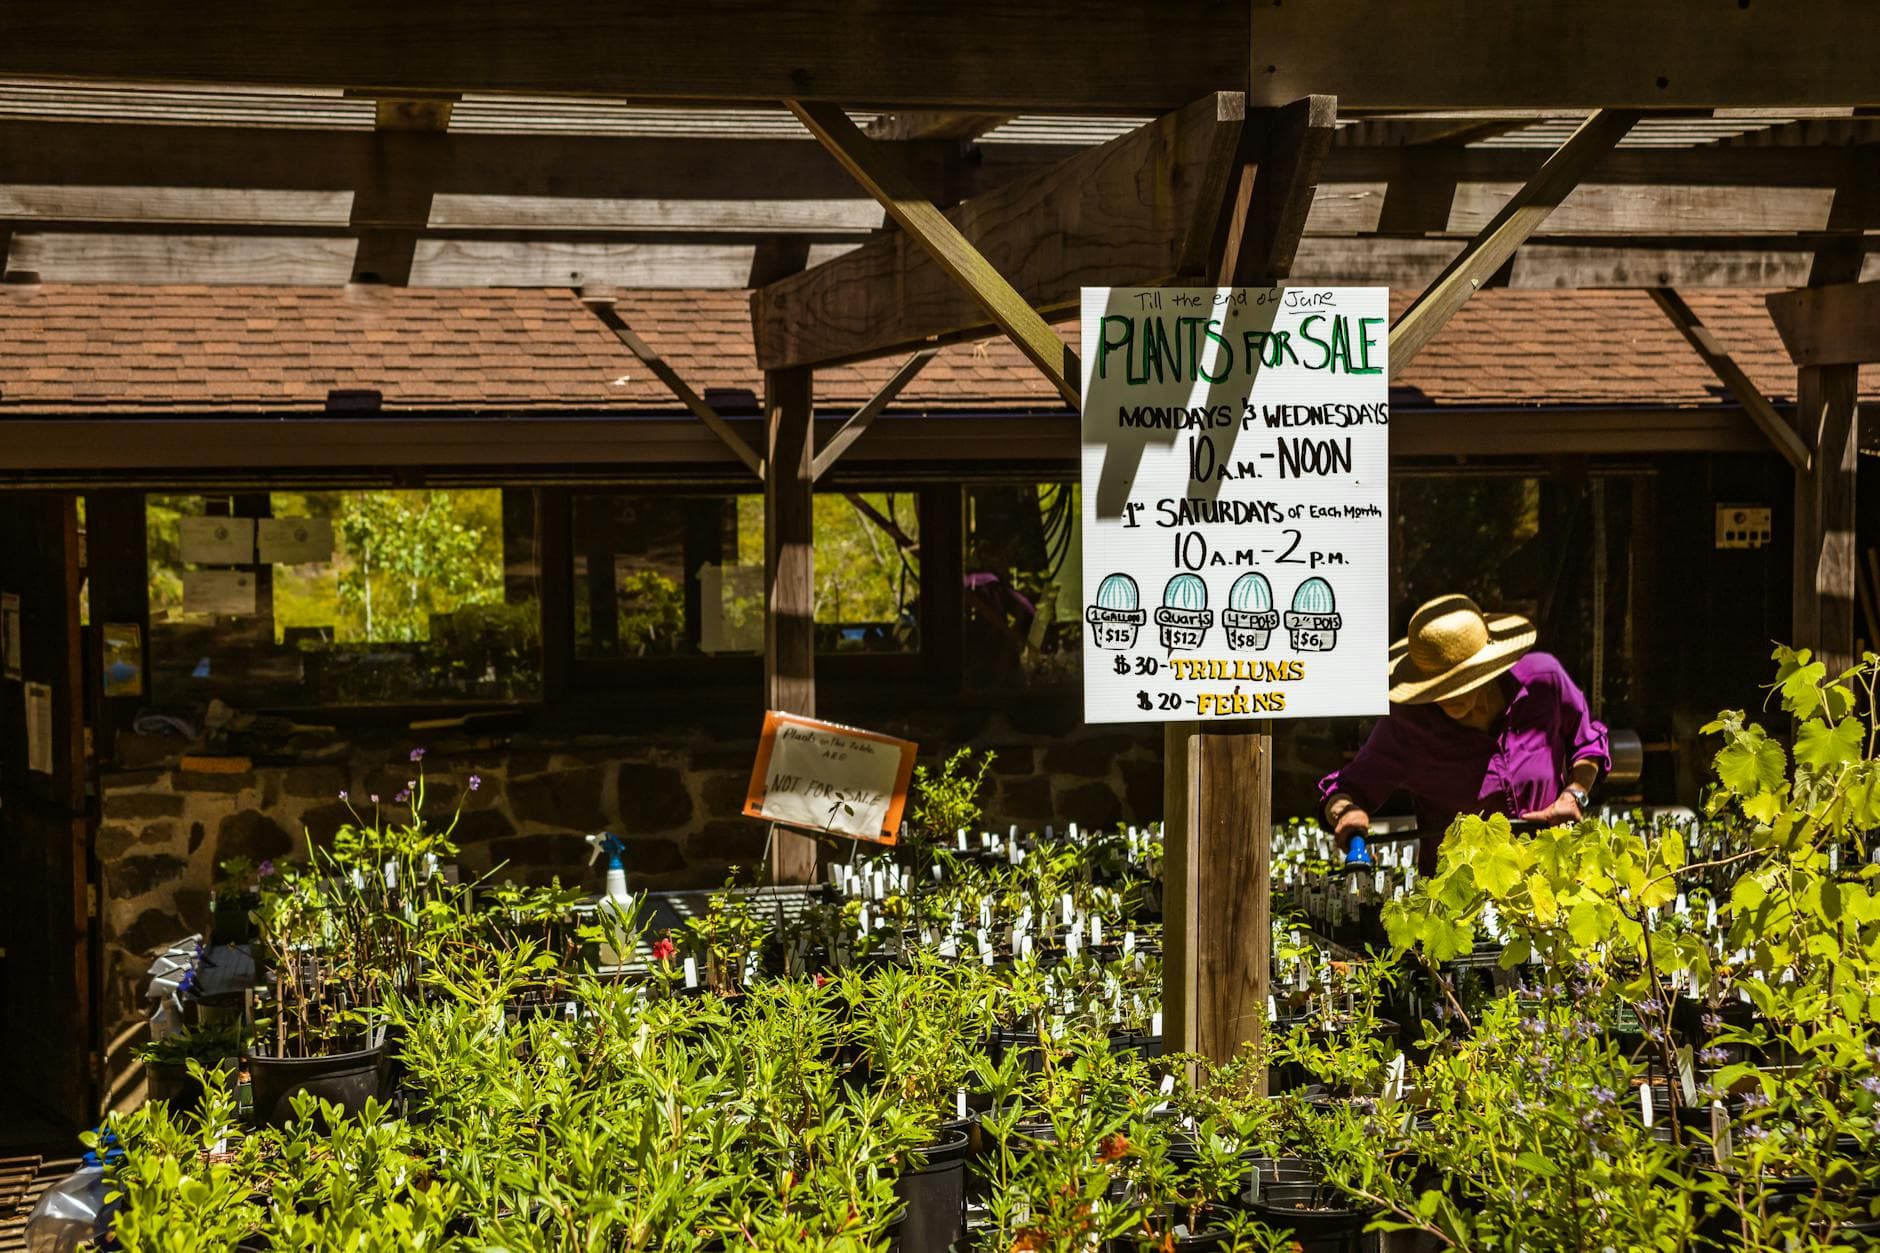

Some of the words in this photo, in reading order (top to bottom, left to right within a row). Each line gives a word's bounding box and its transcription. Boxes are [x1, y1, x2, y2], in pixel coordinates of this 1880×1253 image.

[1134, 292, 1162, 310] Till
[1173, 292, 1203, 307] the
[1212, 290, 1247, 307] end
[1256, 290, 1280, 306] of
[1284, 291, 1336, 309] June
[1100, 315, 1233, 385] PLANTS
[1243, 331, 1299, 375] FOR
[1300, 314, 1385, 375] SALE
[1119, 404, 1232, 430] MONDAYS
[1263, 403, 1389, 428] WEDNESDAYS
[1156, 498, 1284, 528] SATURDAYS
[1288, 504, 1305, 519] of
[1310, 505, 1342, 518] Each
[1344, 504, 1382, 519] Month
[1091, 610, 1098, 621] 1
[1159, 610, 1210, 627] Quarts
[1105, 628, 1130, 642] $15
[1173, 630, 1197, 645] $12
[1237, 633, 1255, 648] $8
[1300, 632, 1319, 647] $6
[782, 727, 816, 744] Plants
[770, 773, 802, 793] NOT
[803, 779, 834, 798] FOR
[842, 787, 883, 806] SALE
